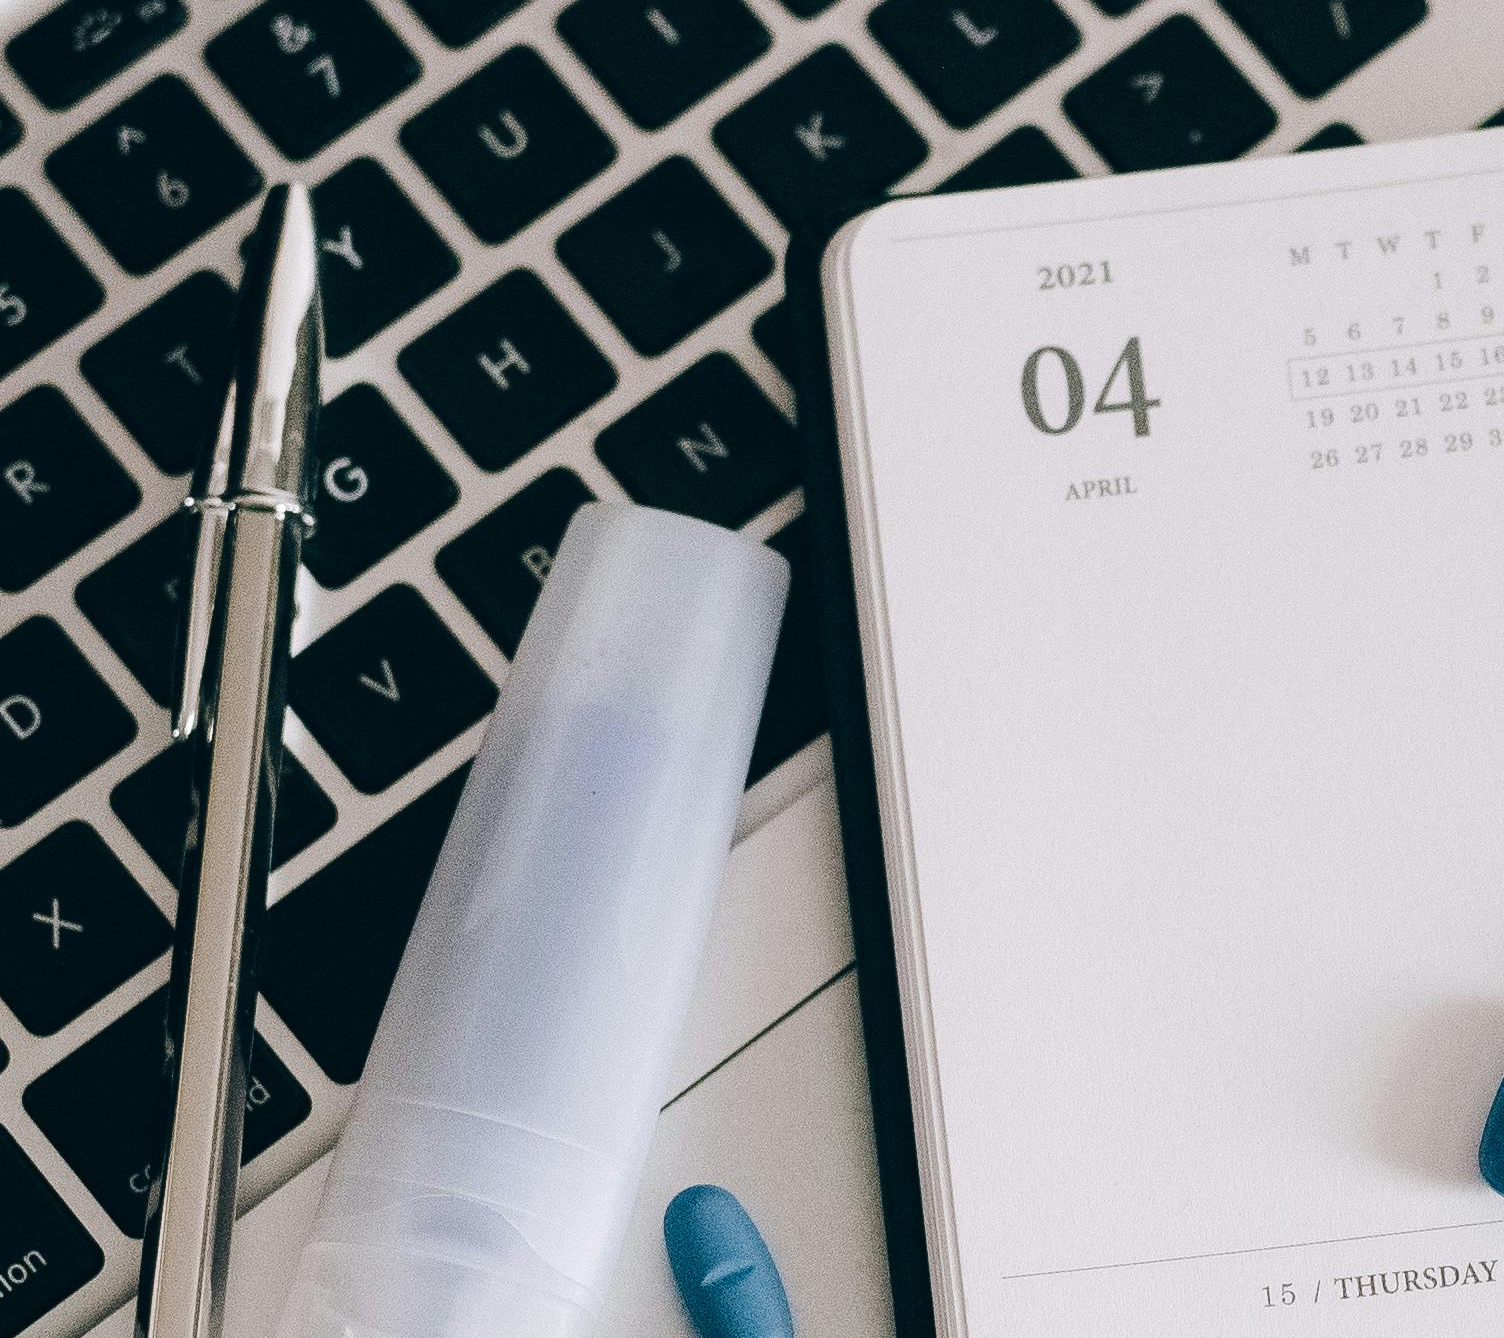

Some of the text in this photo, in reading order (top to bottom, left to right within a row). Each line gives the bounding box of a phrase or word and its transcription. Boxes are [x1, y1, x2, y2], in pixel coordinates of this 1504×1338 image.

[952, 12, 997, 47] L
[310, 55, 340, 95] 7
[480, 111, 529, 159] U
[797, 115, 841, 157] K
[158, 173, 189, 206] 6
[323, 228, 362, 268] Y
[1288, 245, 1311, 266] M
[1334, 240, 1352, 261] T
[1376, 235, 1400, 254] W
[1423, 229, 1441, 250] T
[1470, 223, 1485, 244] F
[1038, 259, 1113, 292] 2021
[1432, 270, 1443, 291] 1
[1475, 264, 1491, 285] 2
[1303, 326, 1318, 347] 5
[1346, 321, 1362, 341] 6
[1391, 315, 1405, 336] 7
[1436, 312, 1451, 329] 8
[1480, 305, 1496, 325] 9
[479, 339, 530, 389] H
[1302, 367, 1330, 388] 12
[1346, 361, 1375, 383] 13
[1391, 357, 1418, 378] 14
[1435, 349, 1464, 372] 15
[1020, 336, 1161, 438] 04
[1307, 407, 1335, 429] 19
[1349, 402, 1380, 424] 20
[1394, 396, 1422, 419] 21
[1438, 391, 1469, 413] 22
[677, 423, 728, 472] N
[1310, 449, 1340, 470] 26
[1354, 442, 1383, 465] 27
[1399, 438, 1429, 459] 28
[1444, 432, 1474, 454] 29
[4, 461, 47, 503] R
[324, 457, 369, 502] G
[1065, 475, 1135, 501] APRIL
[360, 660, 401, 701] V
[32, 898, 83, 949] X
[1262, 1282, 1298, 1309] 15
[1334, 1259, 1497, 1301] THURSDAY
